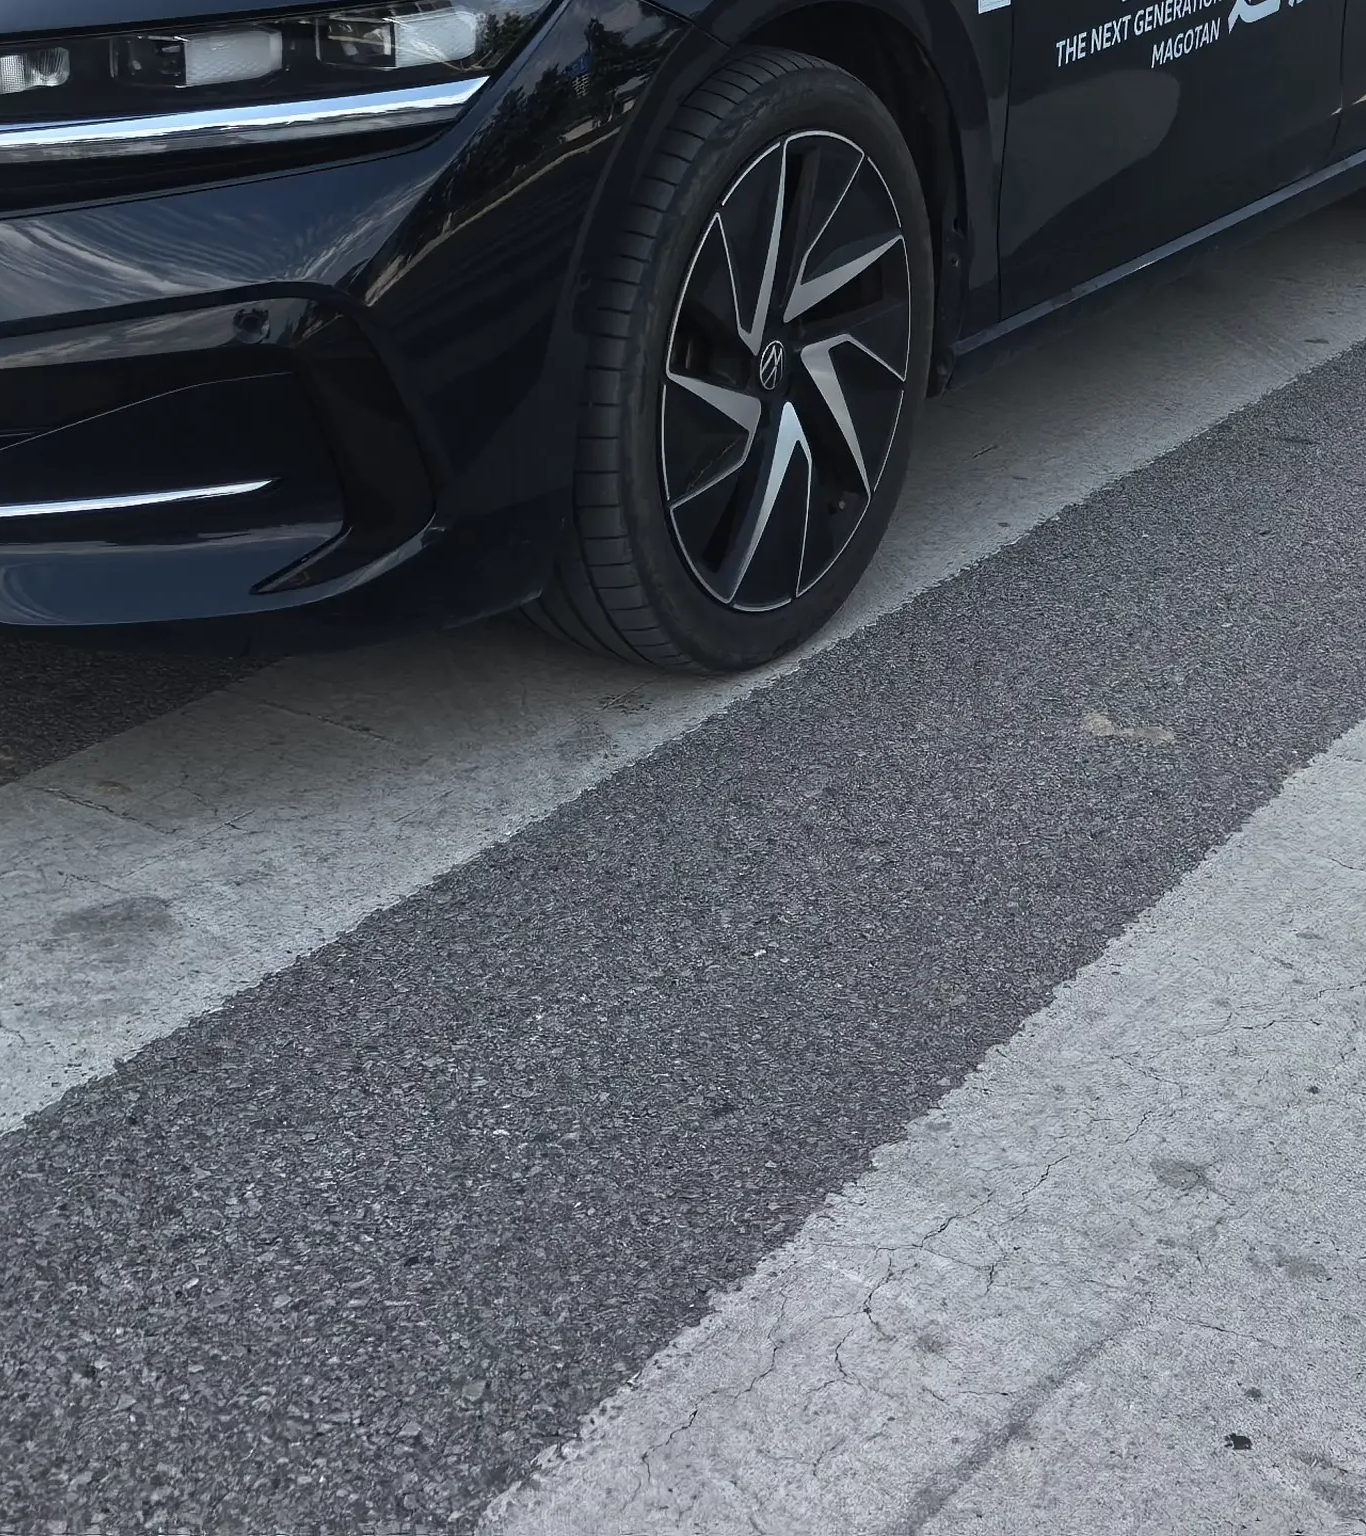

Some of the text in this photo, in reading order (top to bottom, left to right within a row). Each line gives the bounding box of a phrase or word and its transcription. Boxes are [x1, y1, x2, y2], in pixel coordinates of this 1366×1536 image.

[1055, 31, 1087, 68] THE
[1090, 14, 1132, 55] NEXT
[1150, 17, 1221, 69] MAGOTAN
